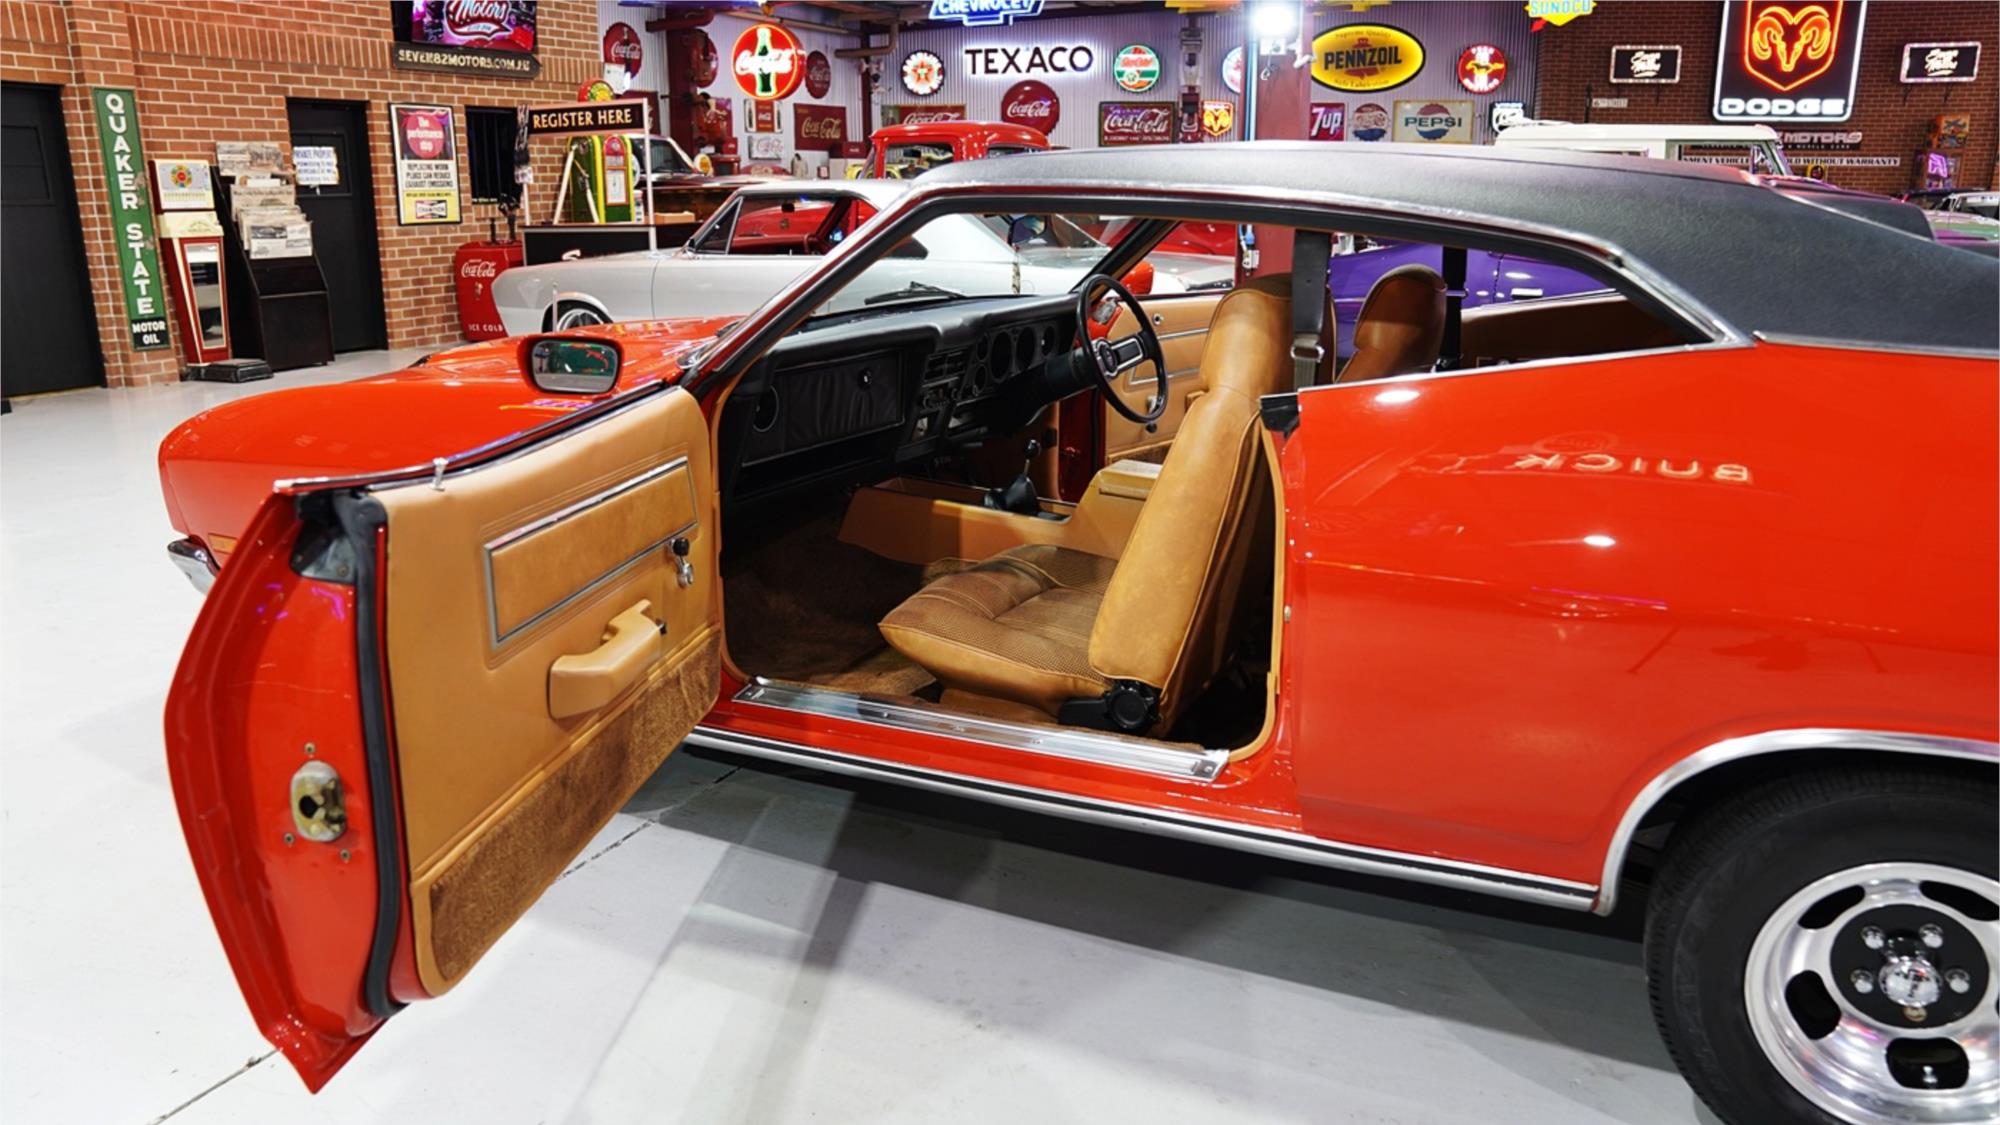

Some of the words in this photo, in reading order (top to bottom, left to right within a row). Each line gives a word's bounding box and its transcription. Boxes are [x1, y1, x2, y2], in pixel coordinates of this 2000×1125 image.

[938, 0, 1029, 14] CHEVROLET
[1531, 0, 1590, 16] SUNOCO
[965, 46, 1093, 75] TEXACO
[1324, 46, 1402, 70] PENNZOIL
[1007, 100, 1052, 118] Coca-Cola
[1721, 97, 1846, 115] DODGE
[532, 111, 594, 129] REGISTER
[597, 108, 632, 125] HERE
[1103, 108, 1170, 134] Coca-Cola
[1311, 107, 1343, 137] 7up
[1405, 117, 1461, 127] PEPSI
[801, 117, 842, 139] Coca-Cola
[1784, 131, 1863, 143] MOTORS
[105, 94, 138, 210] QUAKER
[127, 223, 155, 315] STATE
[461, 259, 497, 278] Coca-Cola
[132, 321, 166, 334] MOTOR
[468, 324, 480, 332] ICE
[482, 323, 504, 332] COLD
[142, 333, 160, 345] OIL
